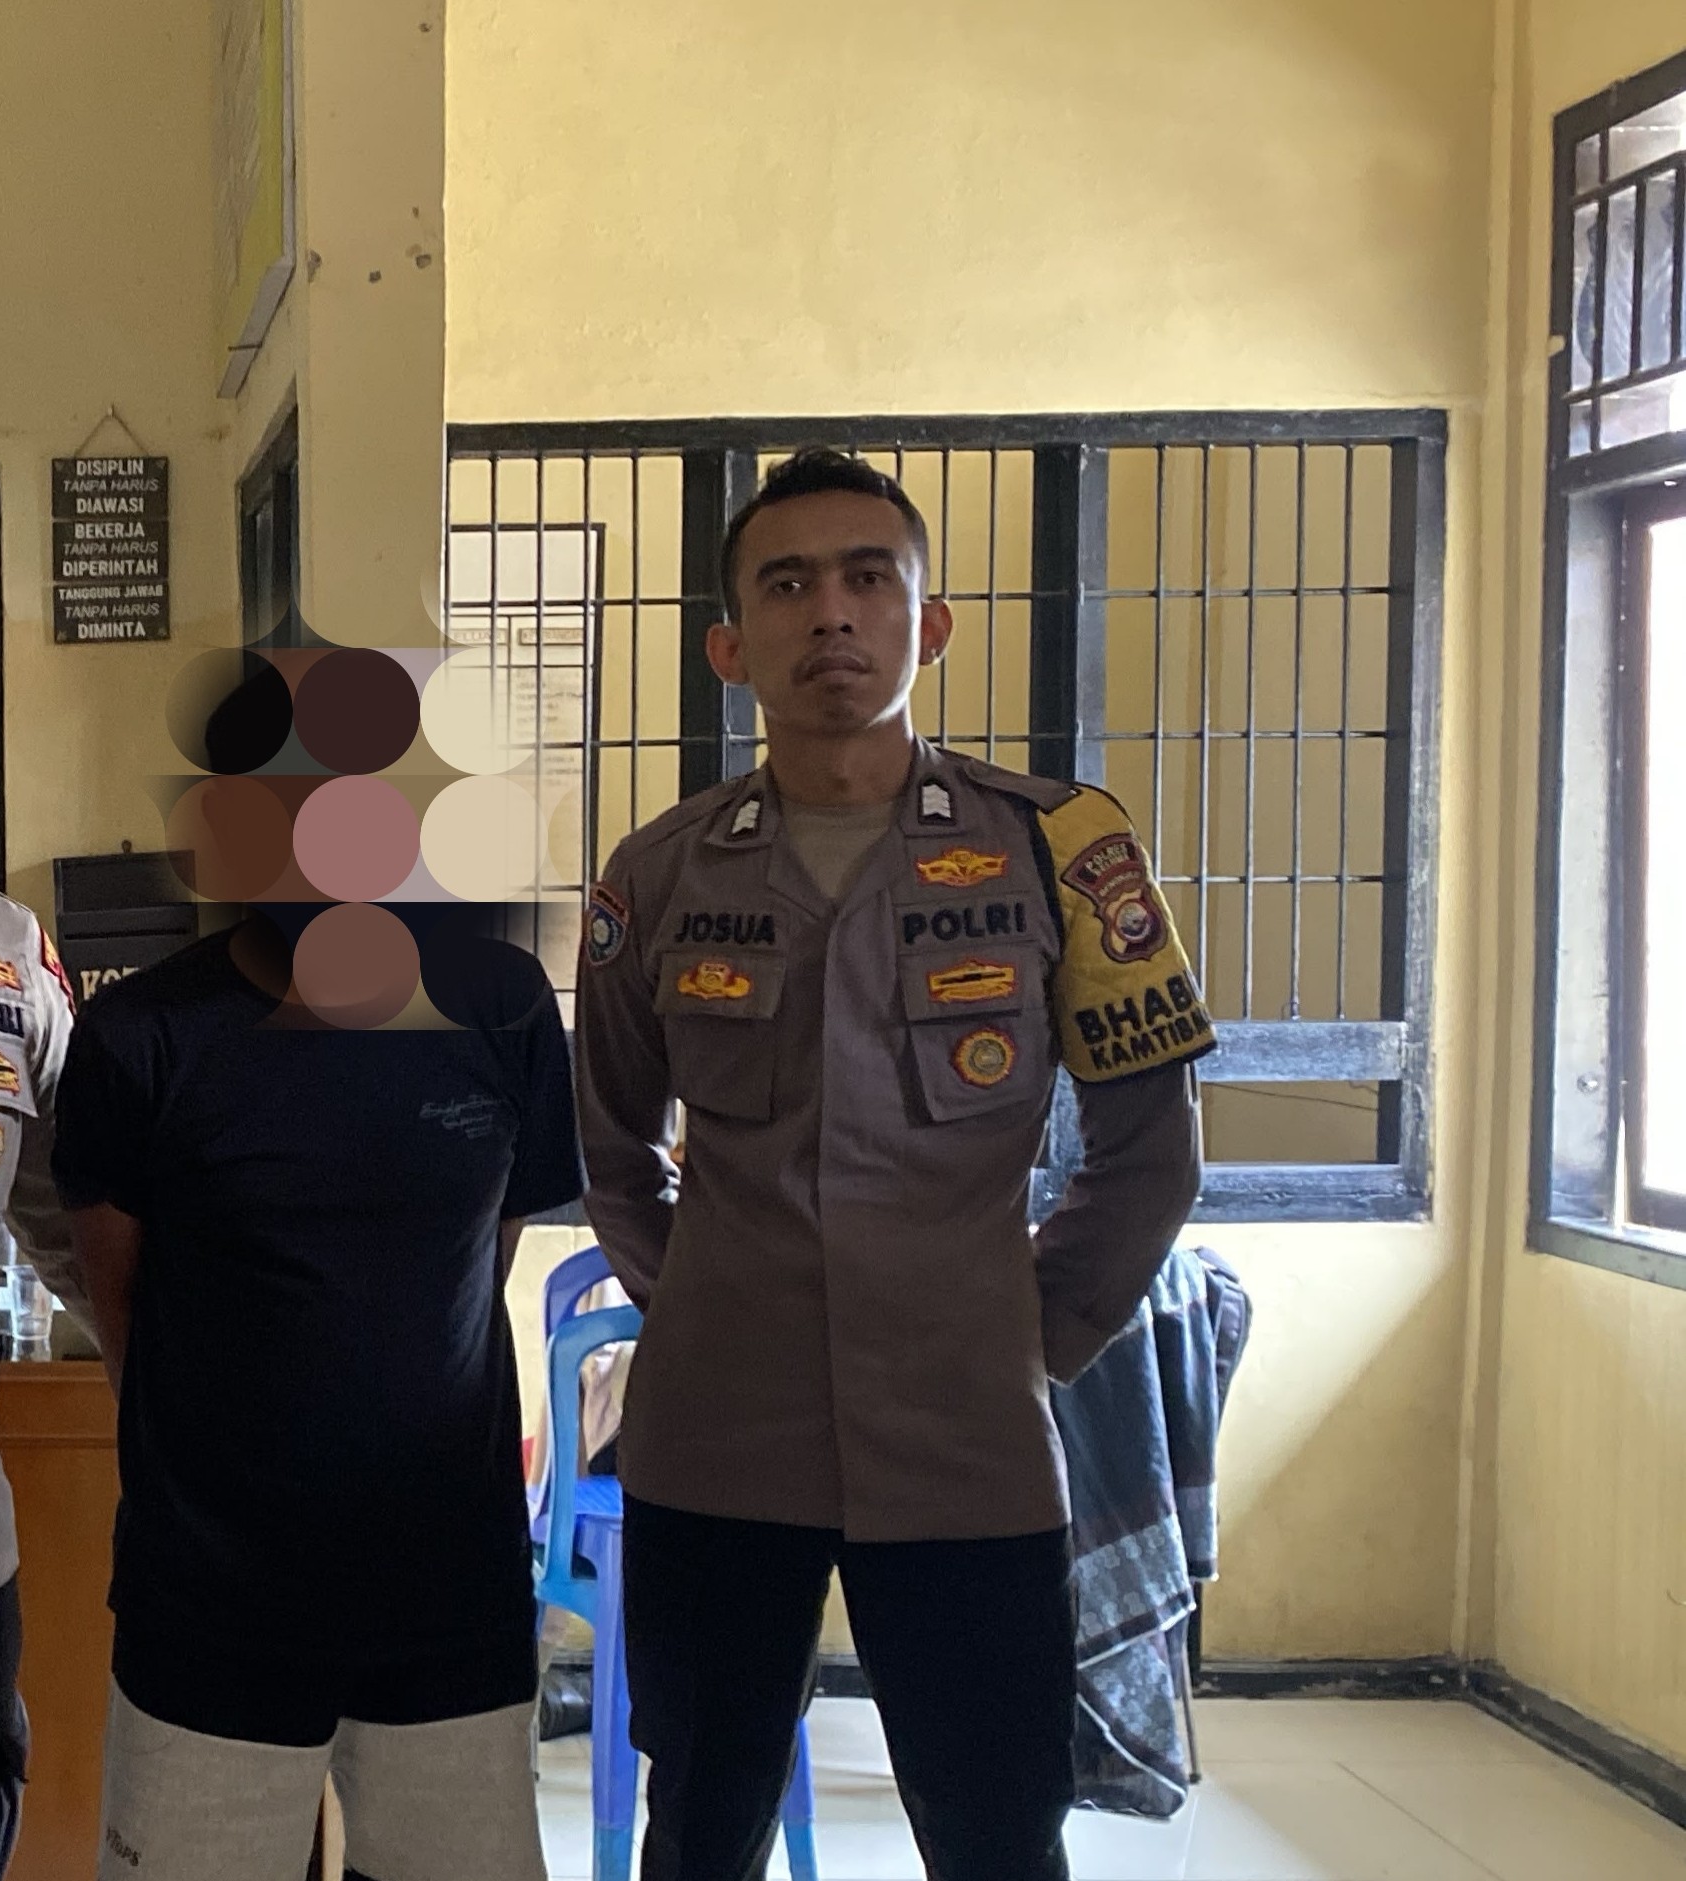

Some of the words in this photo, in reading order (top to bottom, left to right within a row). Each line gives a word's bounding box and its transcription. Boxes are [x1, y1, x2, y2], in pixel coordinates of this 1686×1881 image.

[76, 459, 144, 476] DISIPLIN
[64, 480, 107, 492] TANPA
[111, 478, 159, 491] HARUS
[76, 498, 144, 513] DIAWASI
[75, 522, 145, 539] BEKERJA
[64, 543, 107, 555] TANPA
[111, 541, 159, 554] HARUS
[63, 559, 158, 576] DIPERINTAH
[59, 587, 121, 599] TANGGUNG
[124, 584, 163, 598] JAWAB
[64, 606, 108, 618] TANPA
[112, 603, 159, 616] HARUS
[78, 622, 146, 639] DIMINTA
[674, 912, 776, 945] JOSUA
[902, 902, 1027, 945] POLRI
